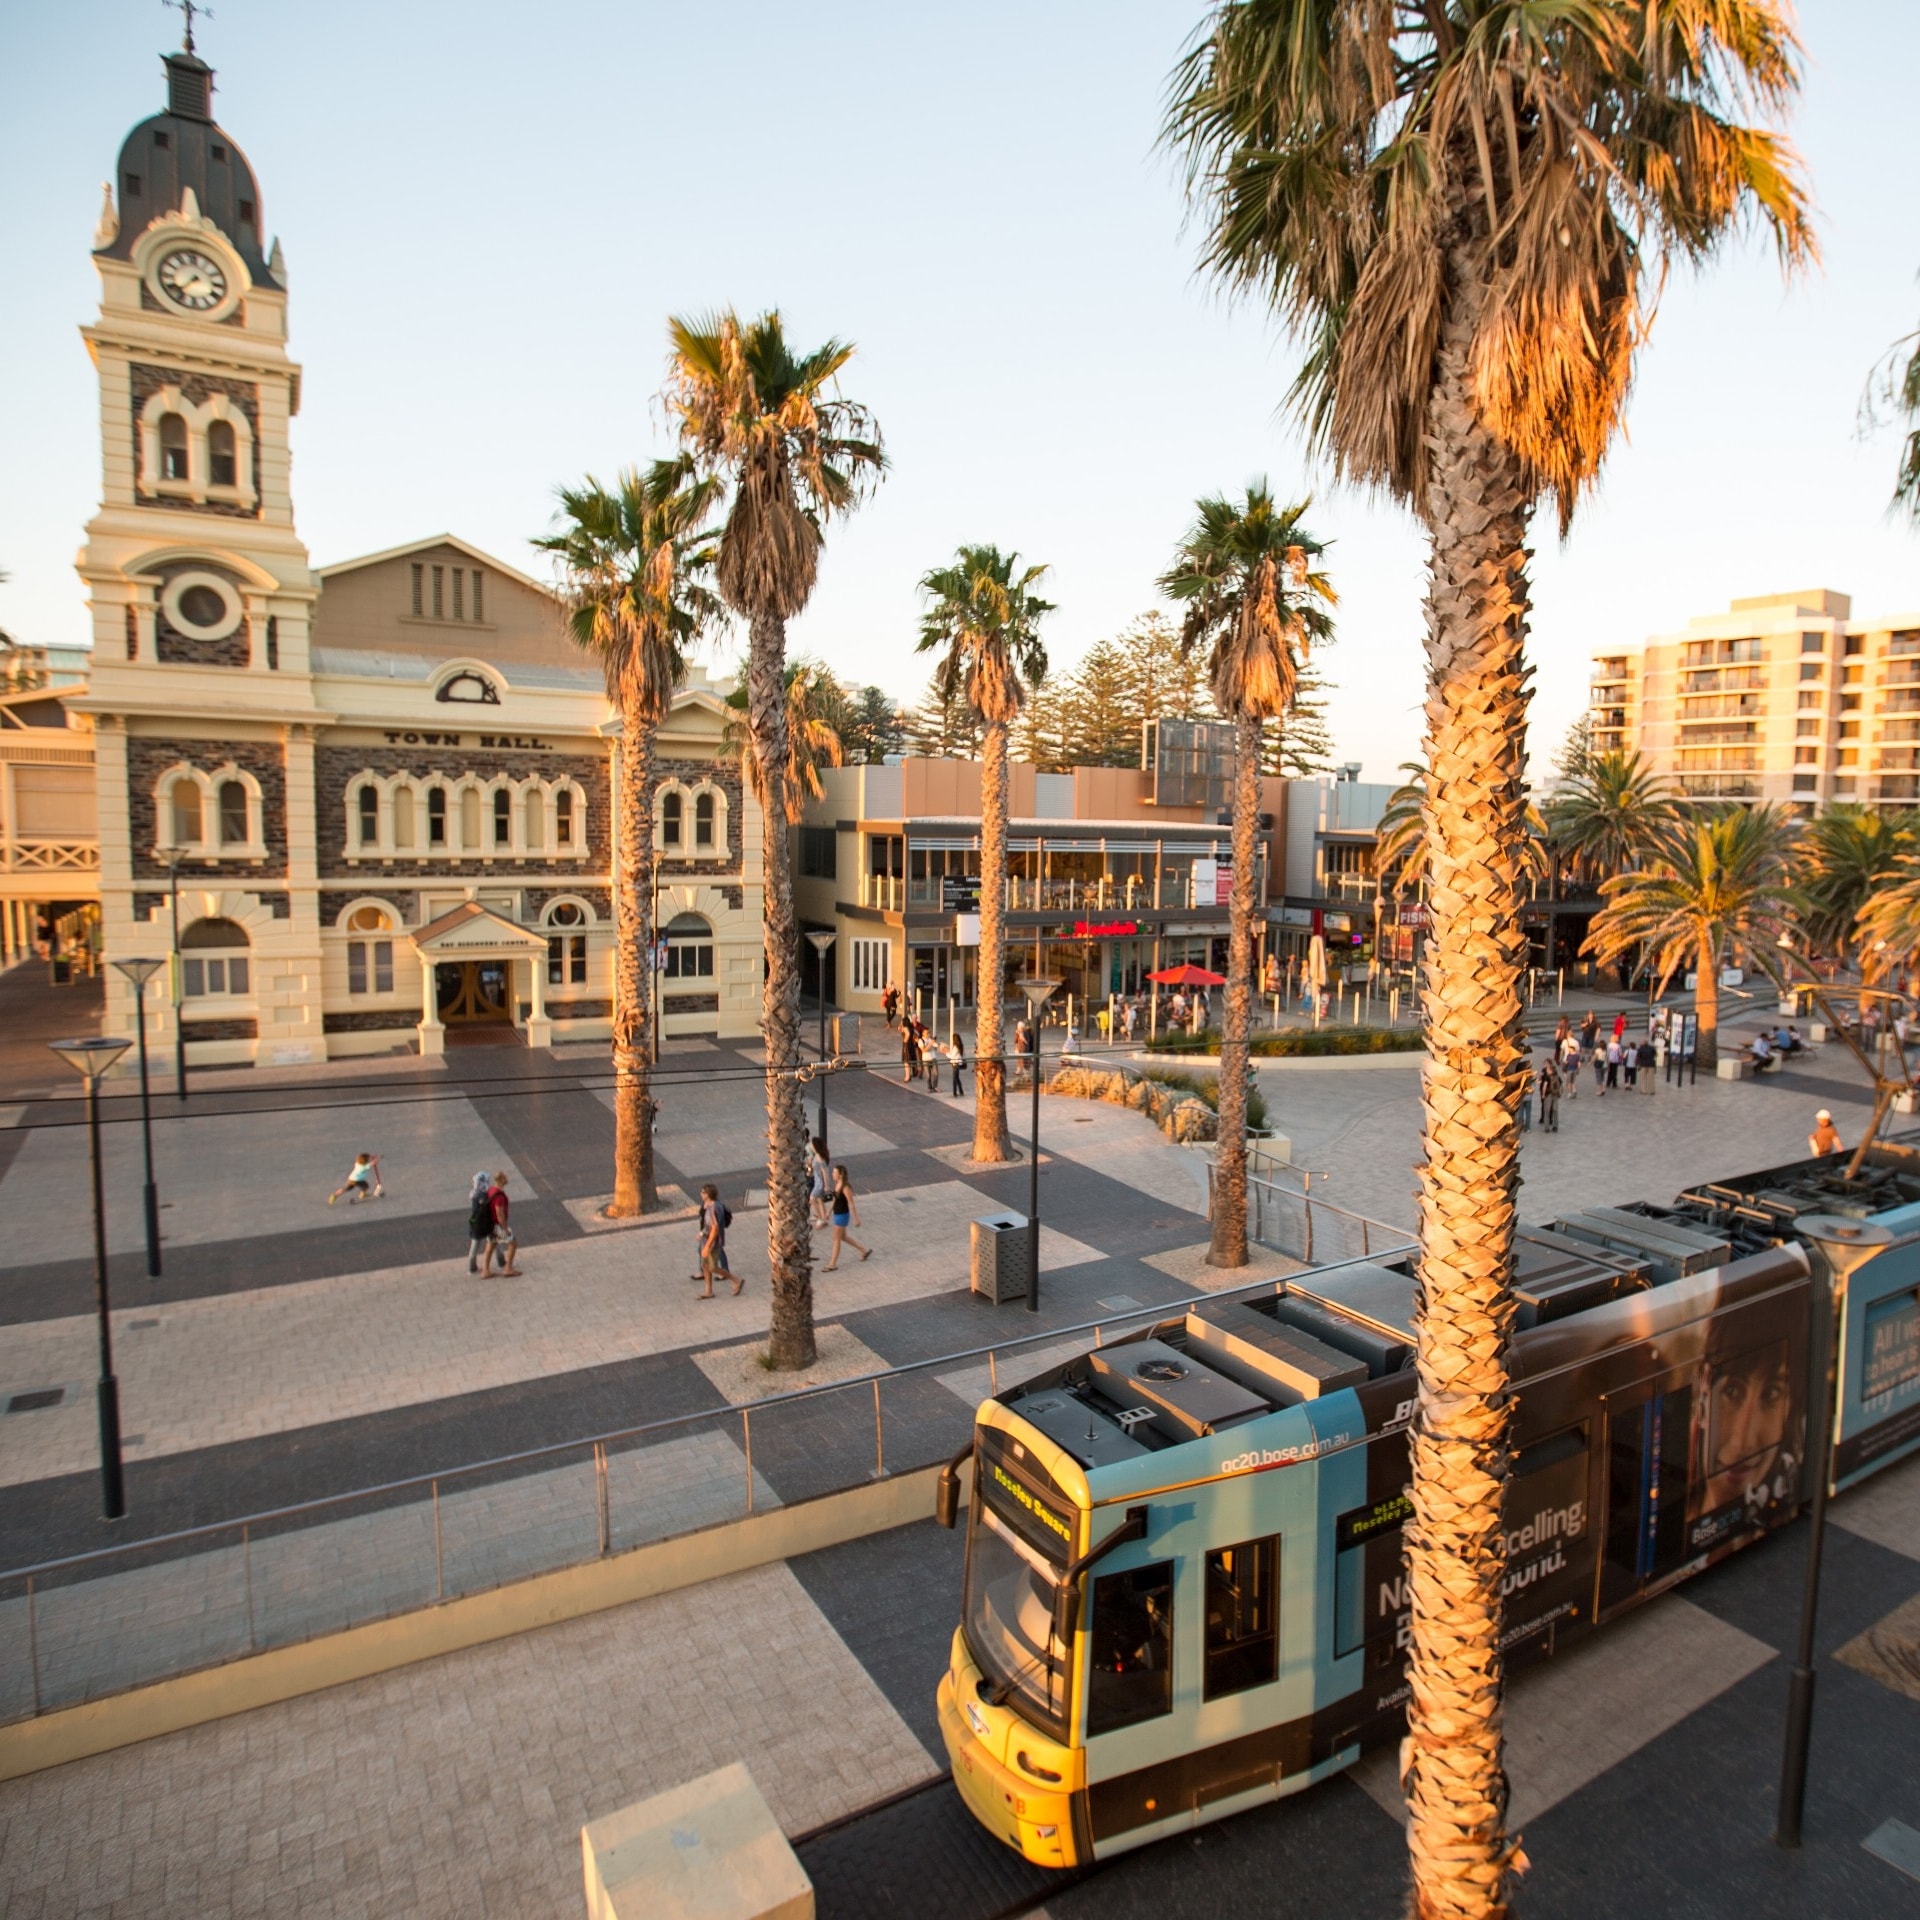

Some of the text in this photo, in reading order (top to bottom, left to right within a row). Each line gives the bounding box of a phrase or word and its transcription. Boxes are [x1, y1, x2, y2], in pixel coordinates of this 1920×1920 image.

[384, 731, 553, 750] TOWN HALL.
[1400, 911, 1426, 924] FISH
[994, 1465, 1072, 1542] Moseley Square
[1352, 1508, 1401, 1535] Moseley
